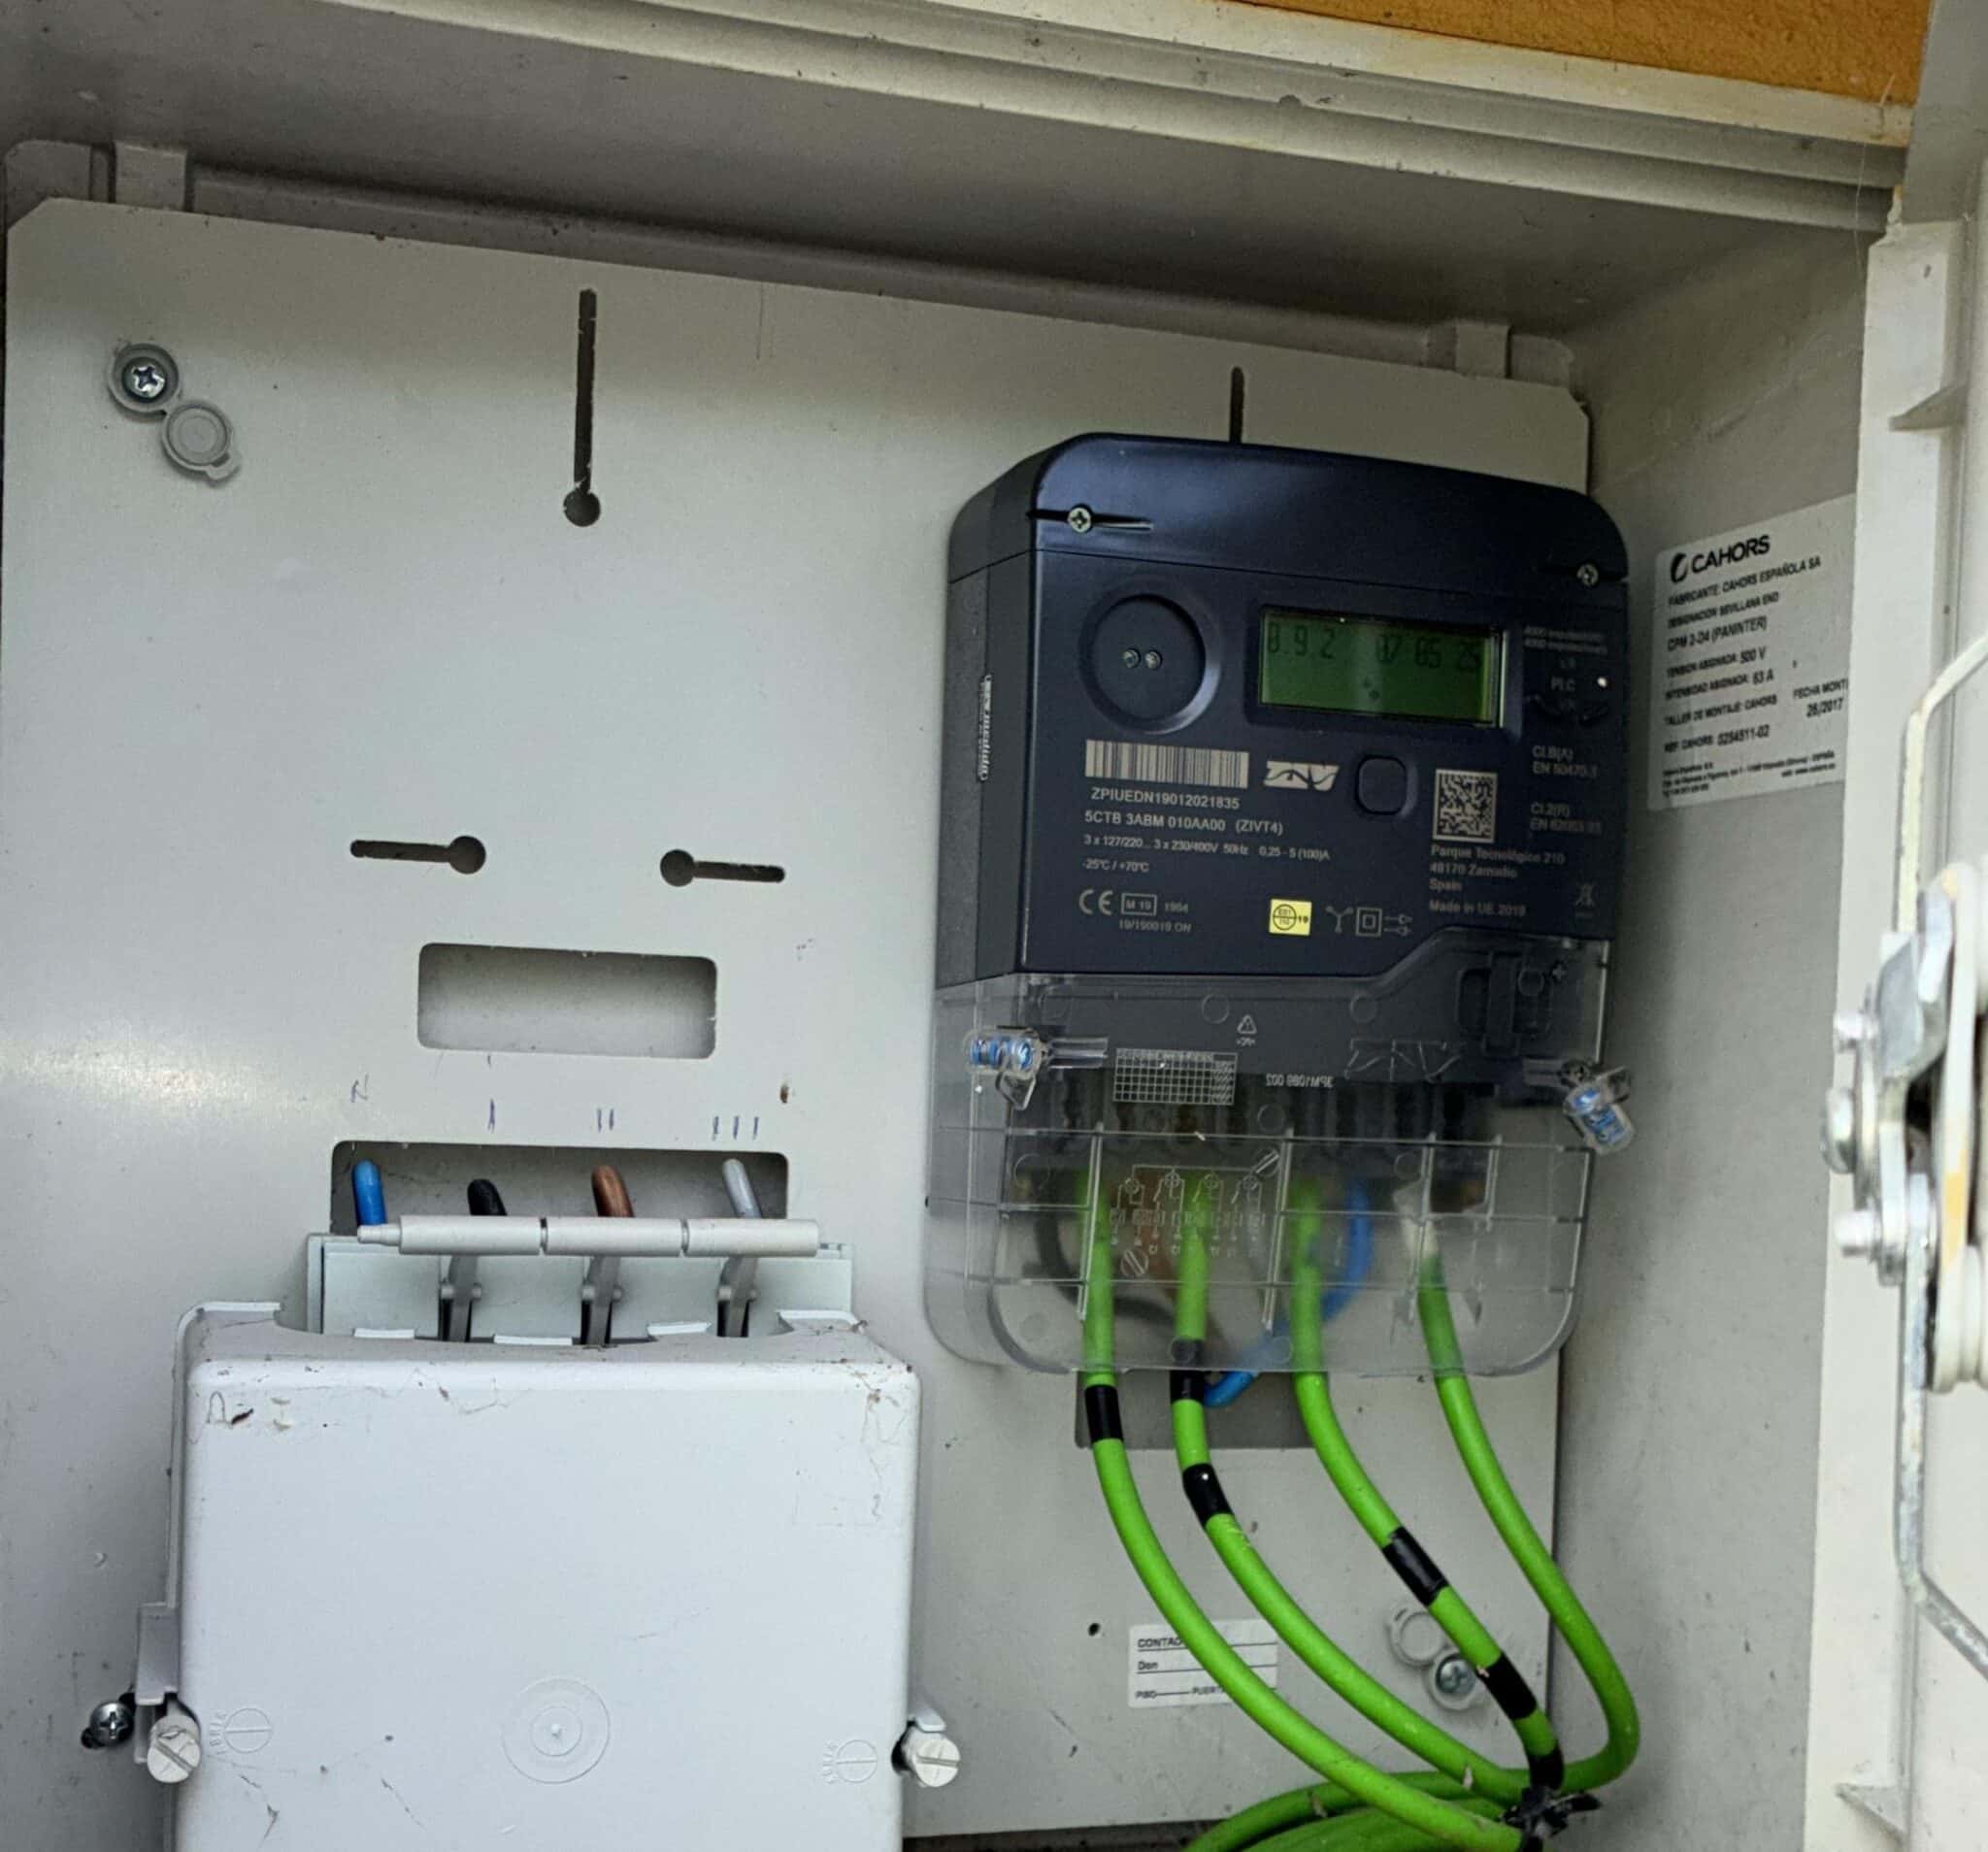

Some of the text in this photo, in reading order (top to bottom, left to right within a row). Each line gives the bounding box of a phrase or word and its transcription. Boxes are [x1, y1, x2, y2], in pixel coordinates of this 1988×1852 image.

[1692, 535, 1771, 574] CAHORS
[1722, 573, 1757, 593] CAHORS
[1759, 646, 1767, 659] V
[1766, 668, 1774, 681] A
[1745, 694, 1777, 711] CAHORS
[1236, 818, 1284, 837] (ZIVT4)
[1082, 834, 1092, 845] 3
[1153, 838, 1162, 848] 3
[1430, 843, 1474, 860] Parque
[1429, 877, 1463, 893] Spain
[1429, 899, 1461, 913] Made
